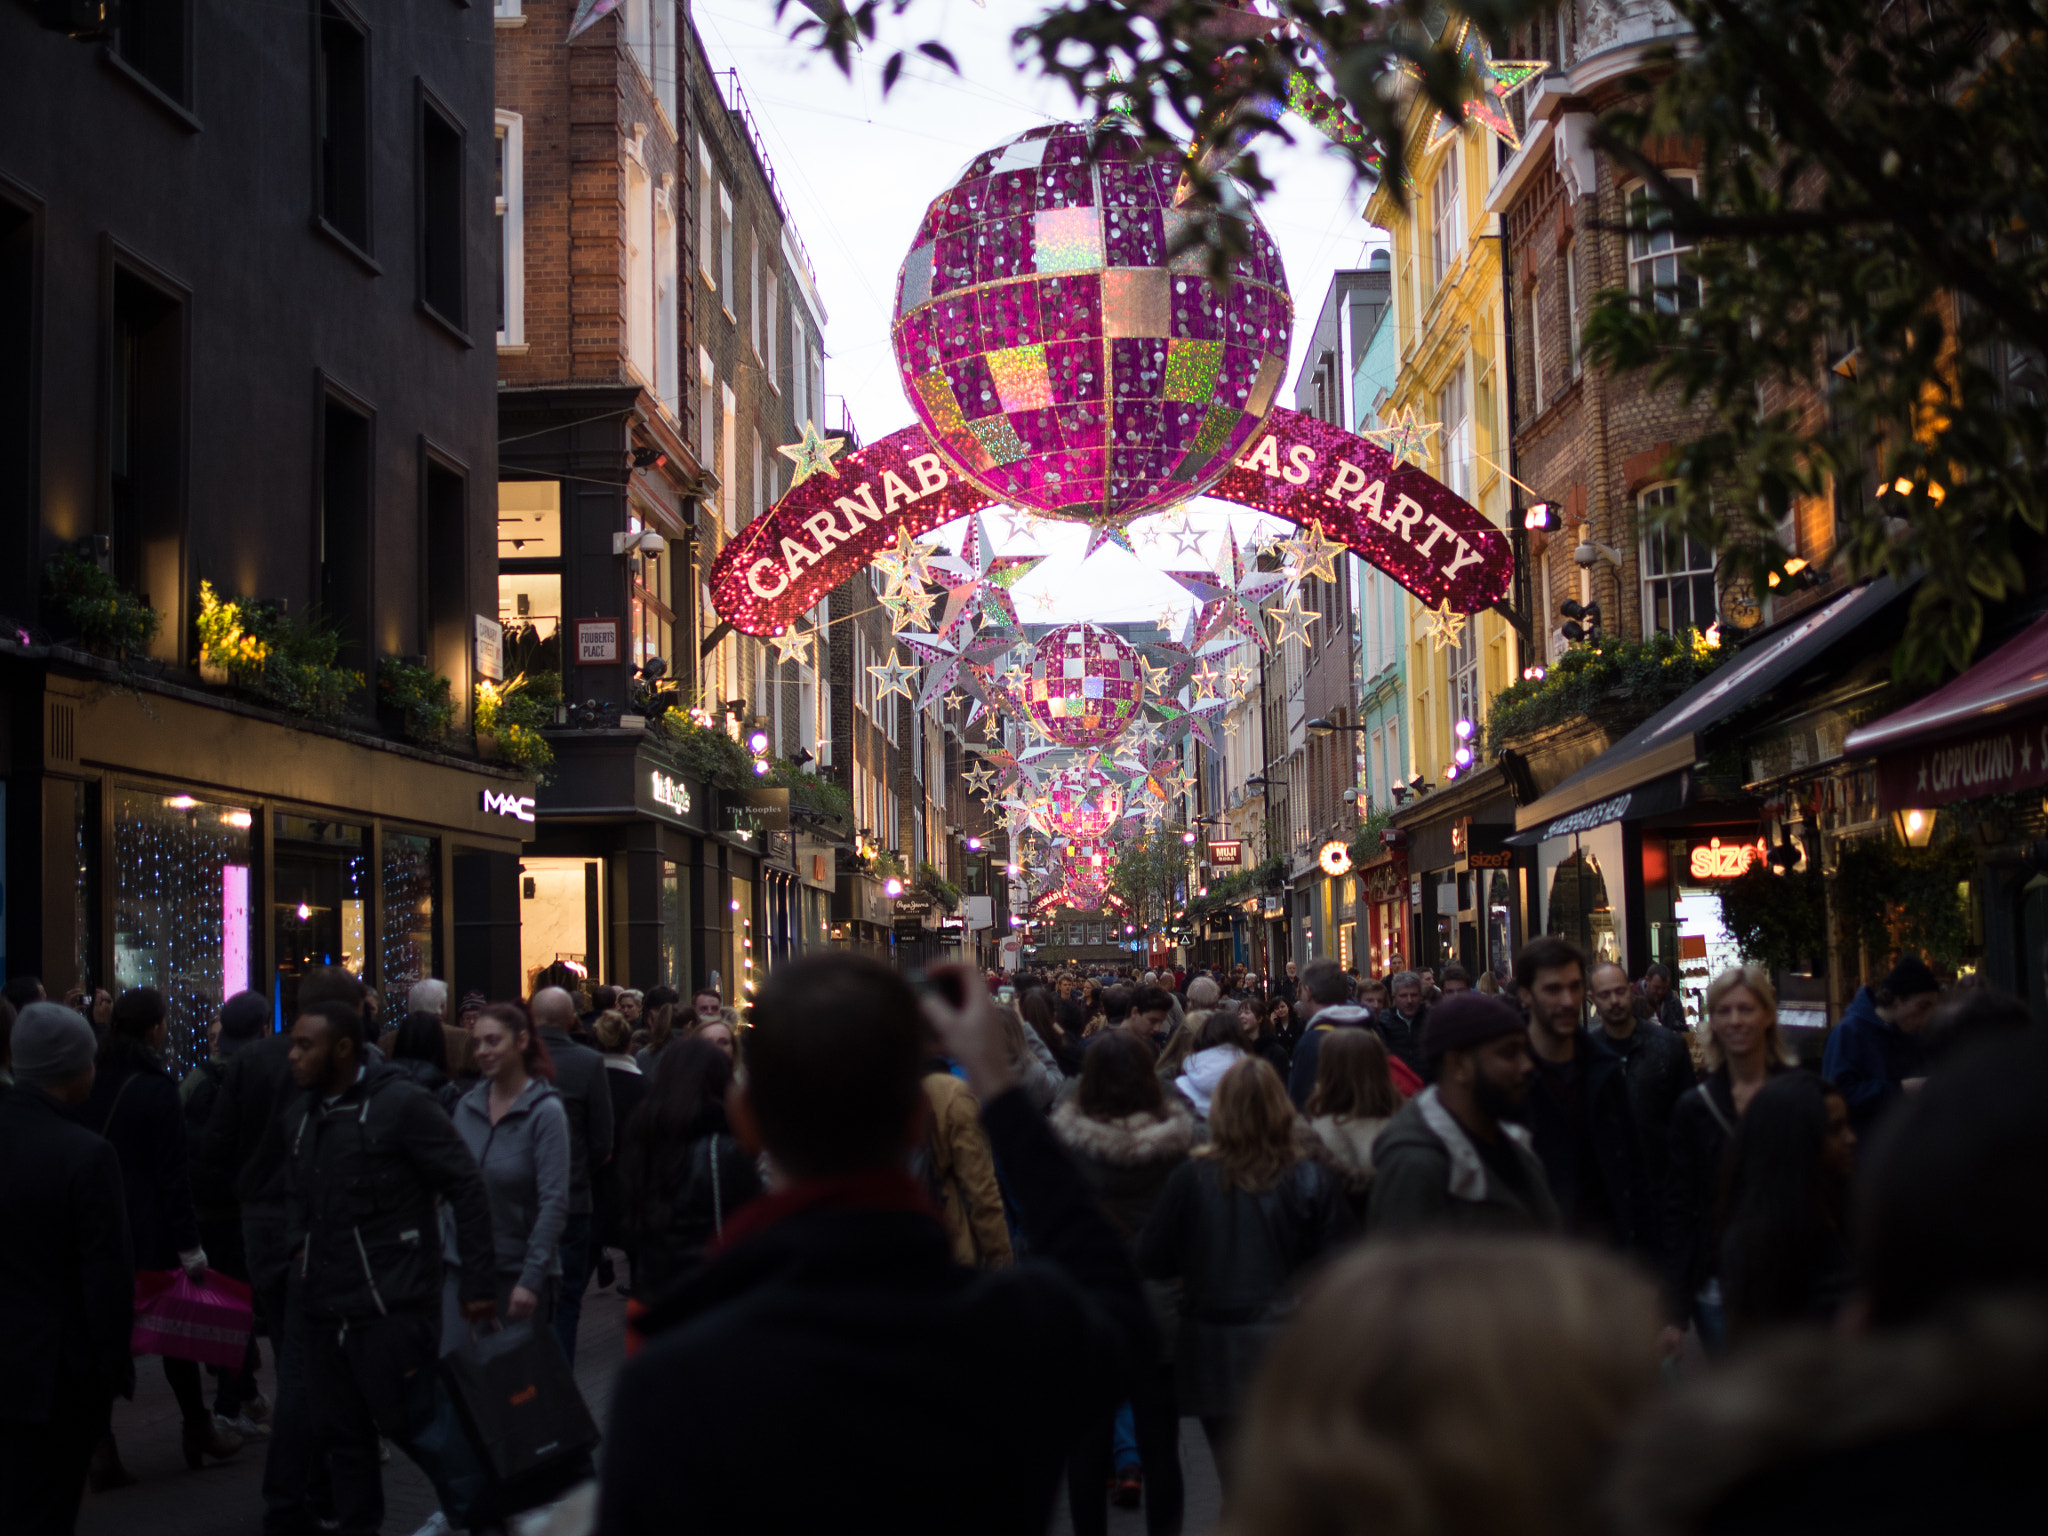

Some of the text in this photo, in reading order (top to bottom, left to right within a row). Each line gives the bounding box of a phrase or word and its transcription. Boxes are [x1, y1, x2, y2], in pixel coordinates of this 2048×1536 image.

[747, 434, 1484, 600] CARNAB AS PARTY
[580, 631, 615, 644] FOUBERT'S
[583, 645, 605, 658] PLACE
[1932, 733, 2013, 792] CAPPUCCINO
[484, 789, 535, 822] MAC
[725, 805, 782, 814] The Kooples
[1216, 847, 1237, 857] MUJI
[1470, 850, 1512, 867] size?
